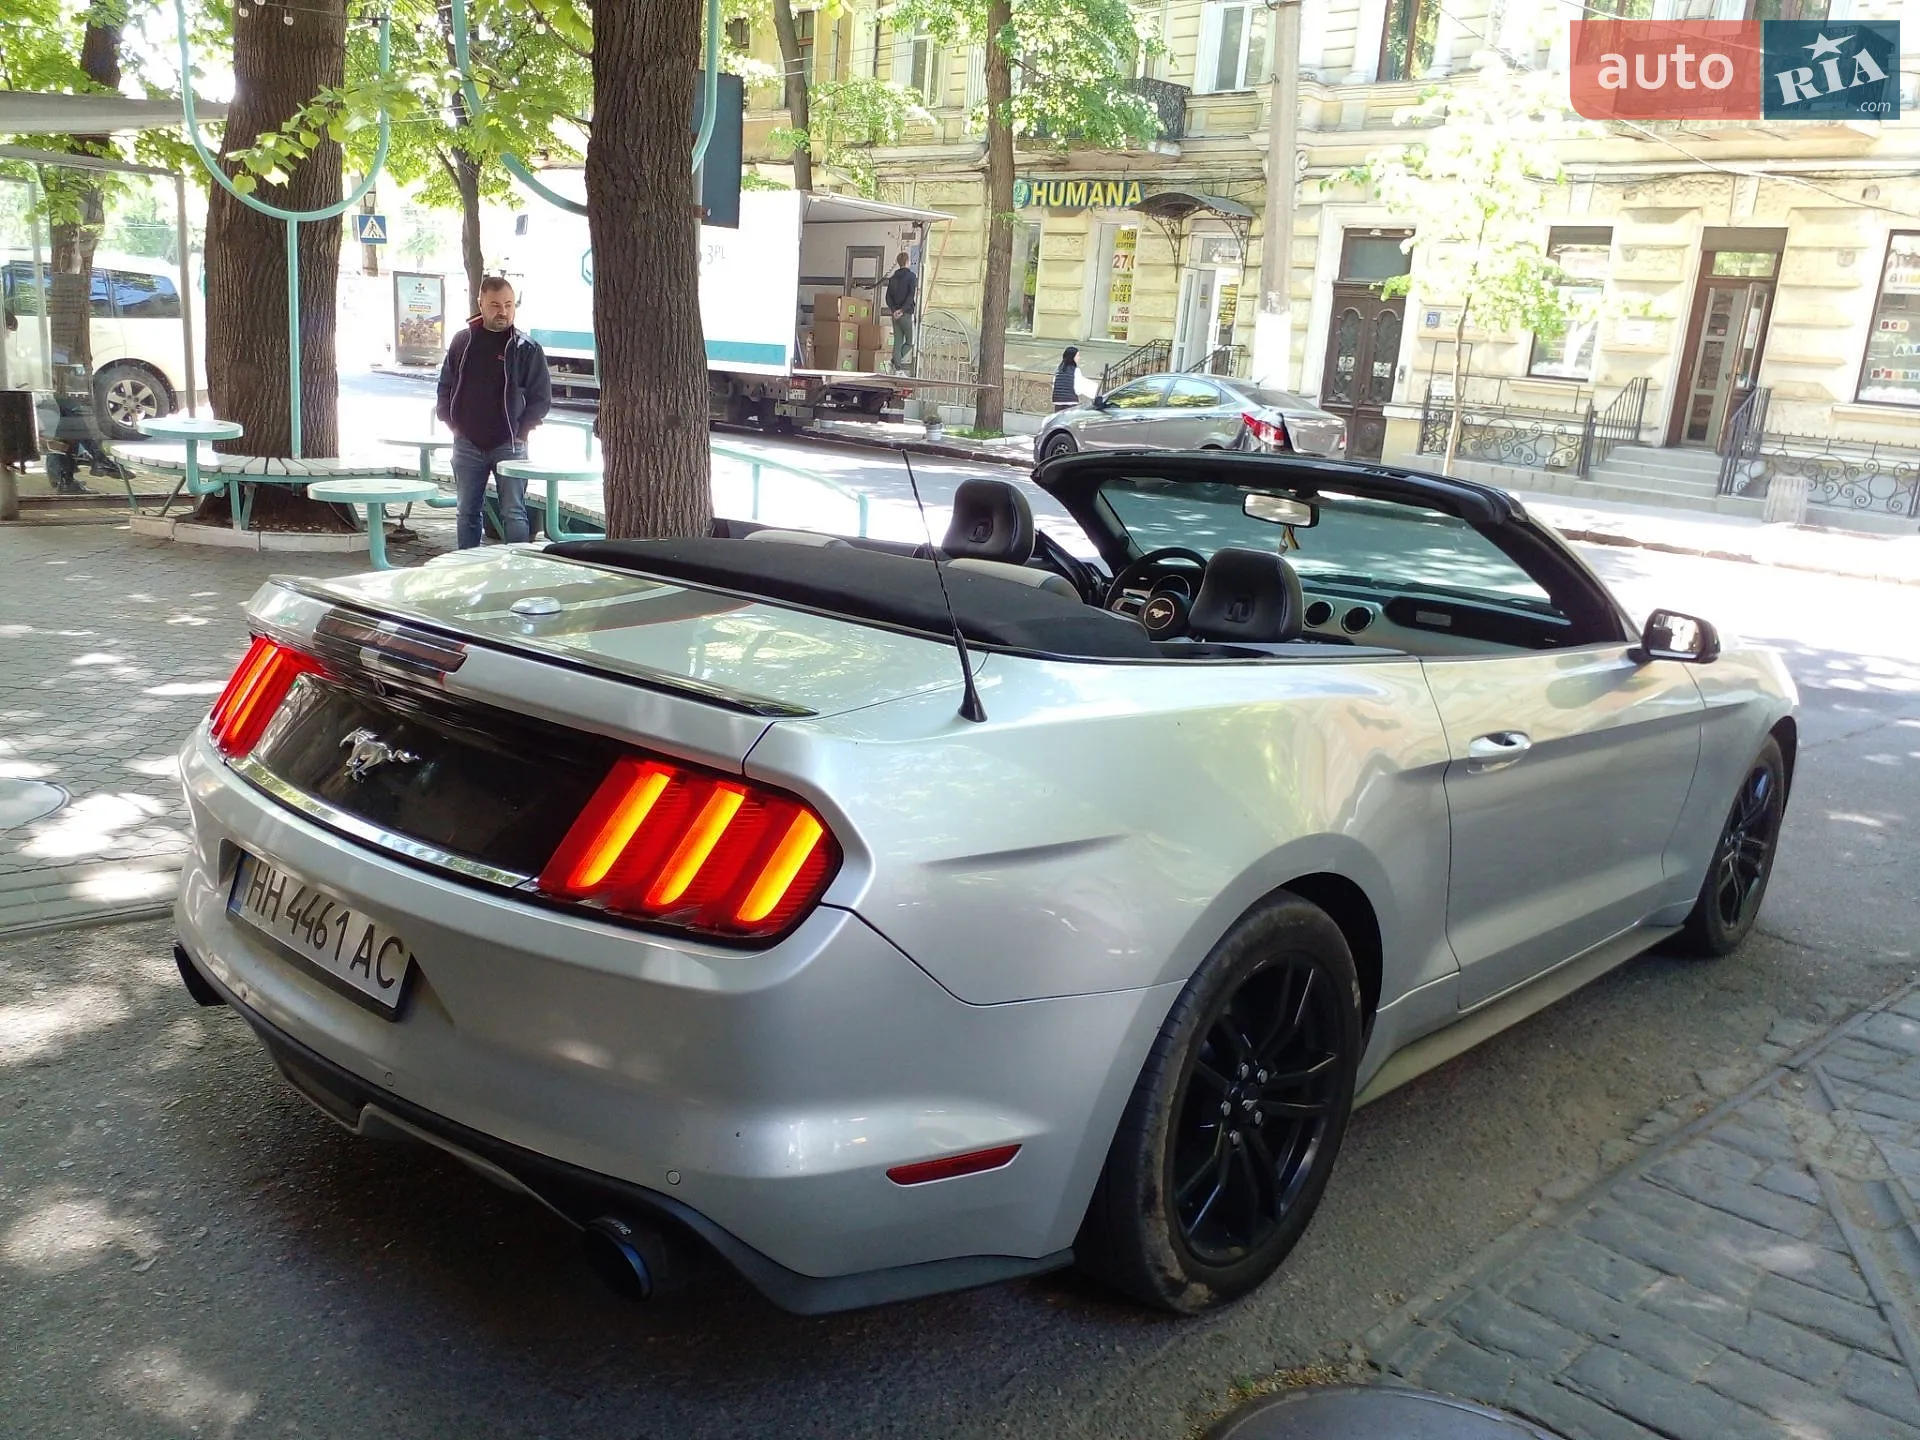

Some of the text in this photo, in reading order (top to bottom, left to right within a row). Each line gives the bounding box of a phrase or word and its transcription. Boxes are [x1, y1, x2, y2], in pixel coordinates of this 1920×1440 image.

[1030, 181, 1142, 207] HUMANA
[246, 861, 404, 990] HH 4461 AC
